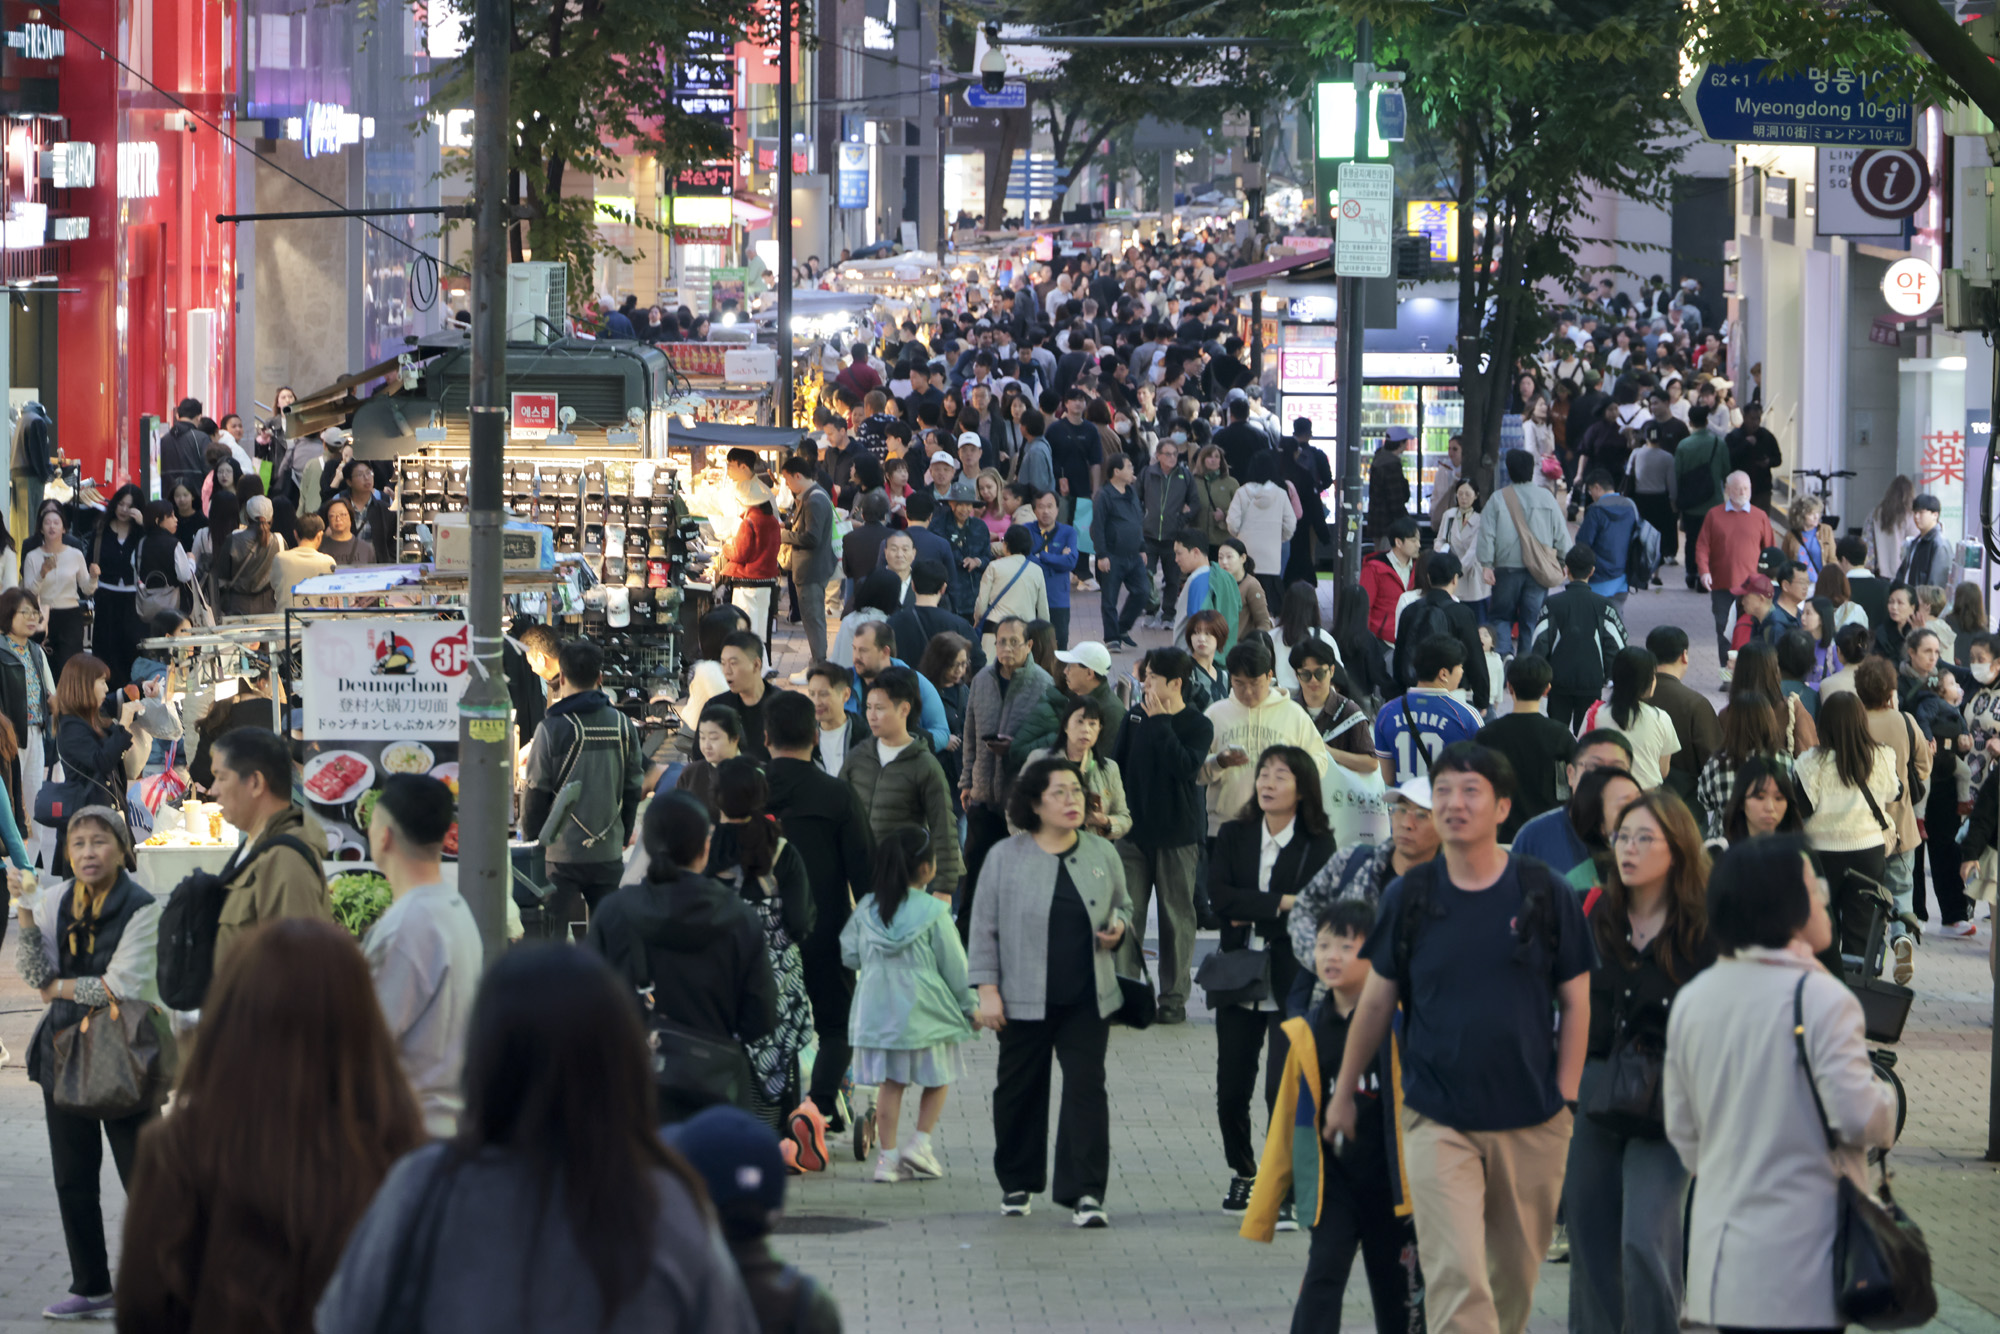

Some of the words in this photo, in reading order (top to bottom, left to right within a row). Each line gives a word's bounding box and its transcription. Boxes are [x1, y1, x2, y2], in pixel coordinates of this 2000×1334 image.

[1711, 73, 1728, 87] 62
[1743, 74, 1749, 87] 1
[1735, 97, 1851, 121] Myeongdong
[1858, 102, 1907, 122] 10-gil
[1753, 125, 1807, 140] 明洞10街
[1896, 272, 1926, 305] 약
[521, 406, 550, 418] 에스원
[434, 643, 468, 673] 3F
[338, 677, 448, 695] Deungchon
[1394, 731, 1444, 783] 10
